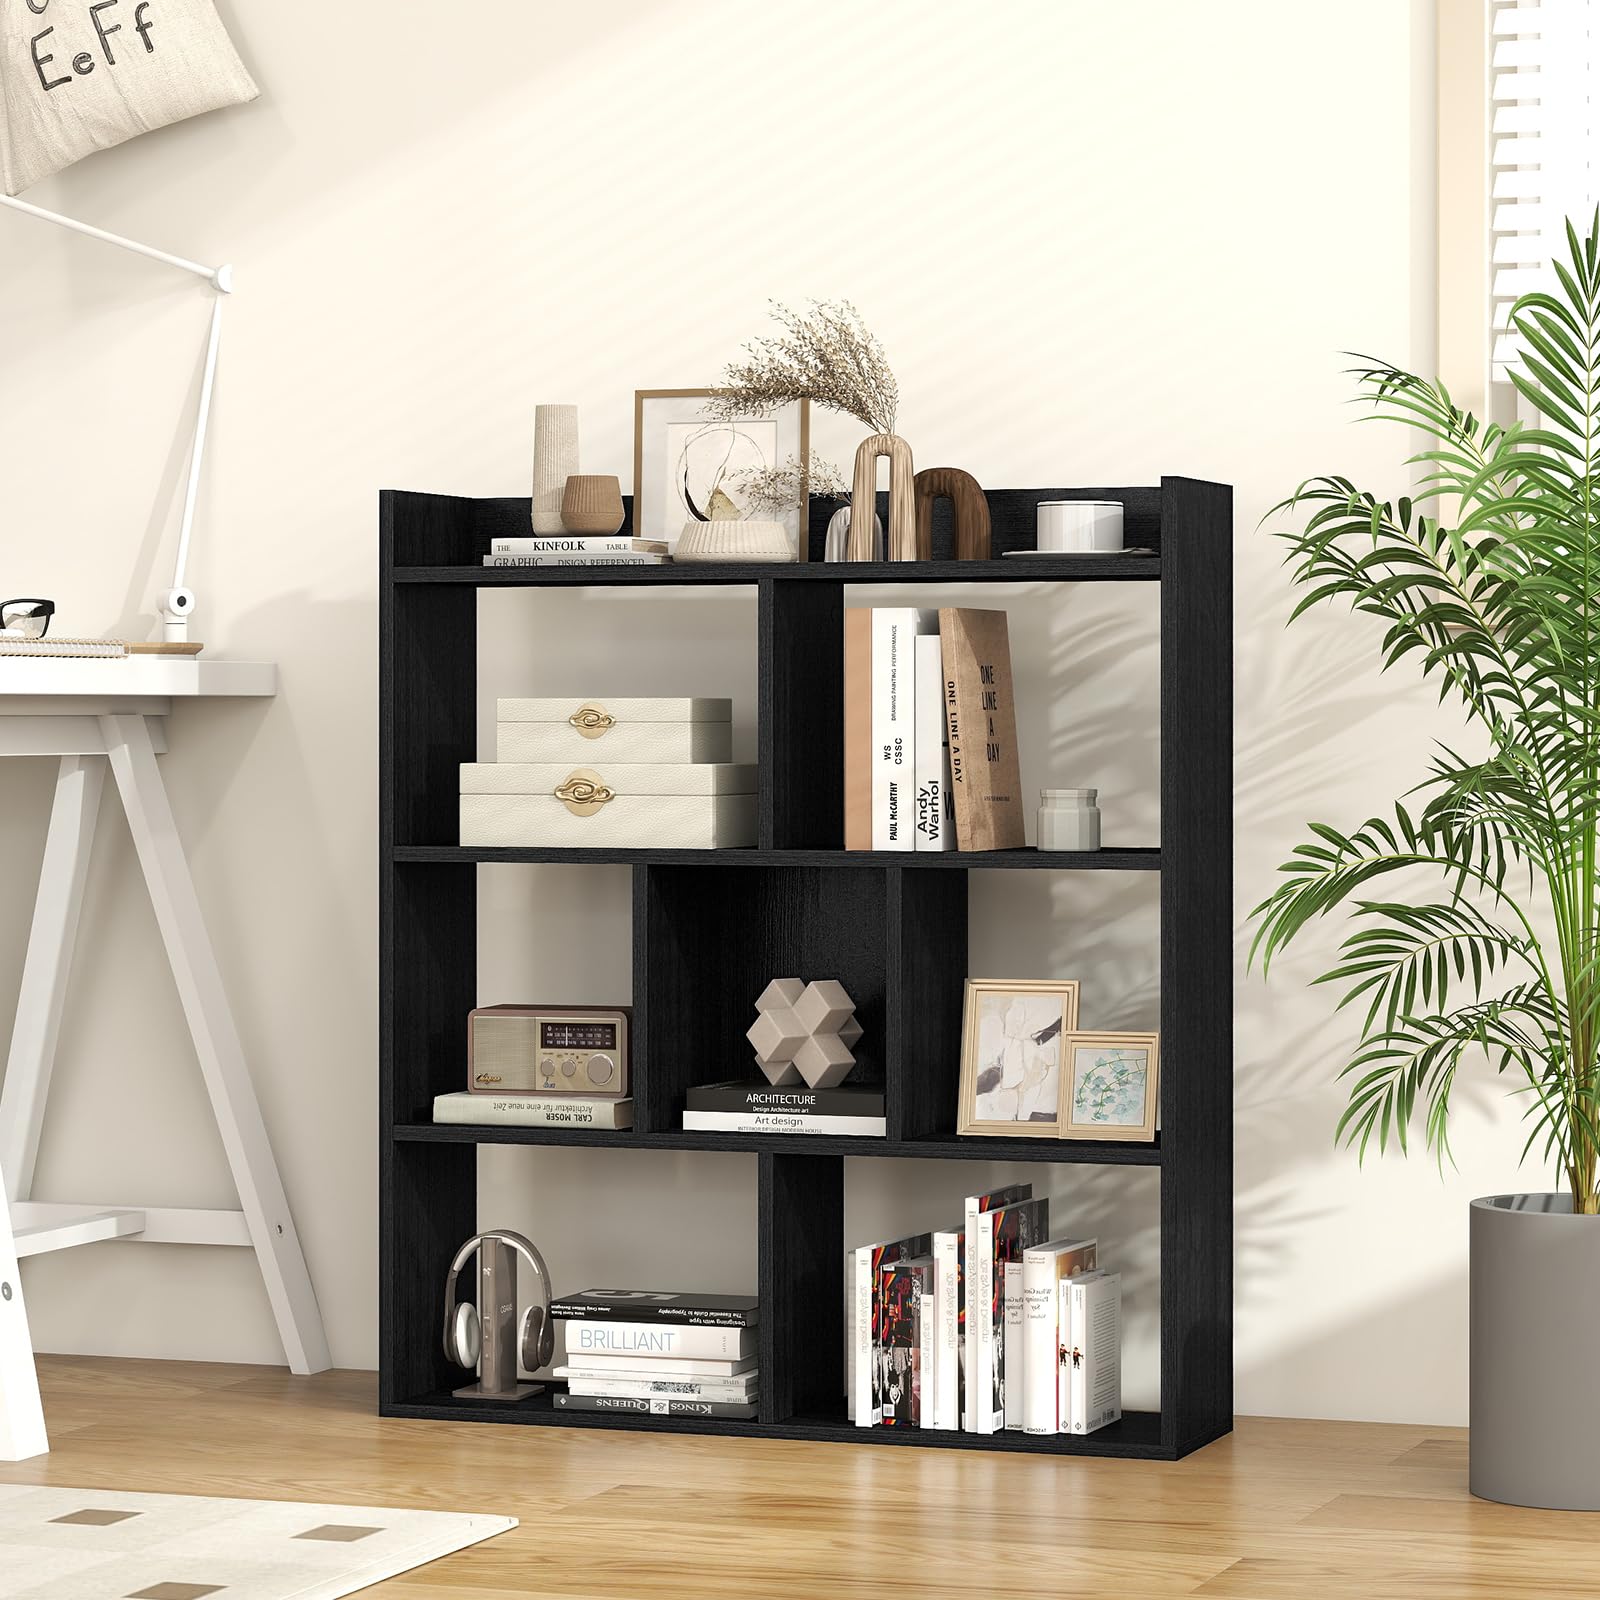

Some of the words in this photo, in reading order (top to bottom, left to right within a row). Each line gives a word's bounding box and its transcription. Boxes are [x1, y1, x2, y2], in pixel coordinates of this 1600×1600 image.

[533, 541, 586, 551] KINFOLK
[493, 557, 543, 567] GRAPHIC
[980, 665, 995, 684] ONE
[947, 681, 957, 706] ONE
[981, 691, 998, 711] LINE
[950, 712, 959, 741] LINE
[989, 717, 995, 737] A
[883, 745, 892, 761] WS
[894, 737, 903, 765] CSSC
[953, 746, 960, 754] A
[986, 743, 1000, 763] DAY
[954, 758, 962, 783] DAY
[889, 781, 898, 820] McCARTHY
[917, 787, 931, 833] Andy
[928, 780, 939, 841] Warhol
[889, 821, 898, 841] PAUL
[493, 1102, 507, 1111] Zeit
[745, 1093, 816, 1105] ARCHITECTURE
[526, 1103, 541, 1111] eine
[554, 1105, 593, 1113] Architektur
[545, 1112, 571, 1121] MOSER
[573, 1113, 592, 1122] CARL
[754, 1116, 770, 1125] Art
[771, 1116, 804, 1127] design
[658, 1308, 687, 1316] Typography
[580, 1328, 676, 1352] BRILLIANT
[596, 1397, 650, 1411] QUEENS
[653, 1401, 667, 1412] &
[670, 1402, 713, 1415] KINGS
